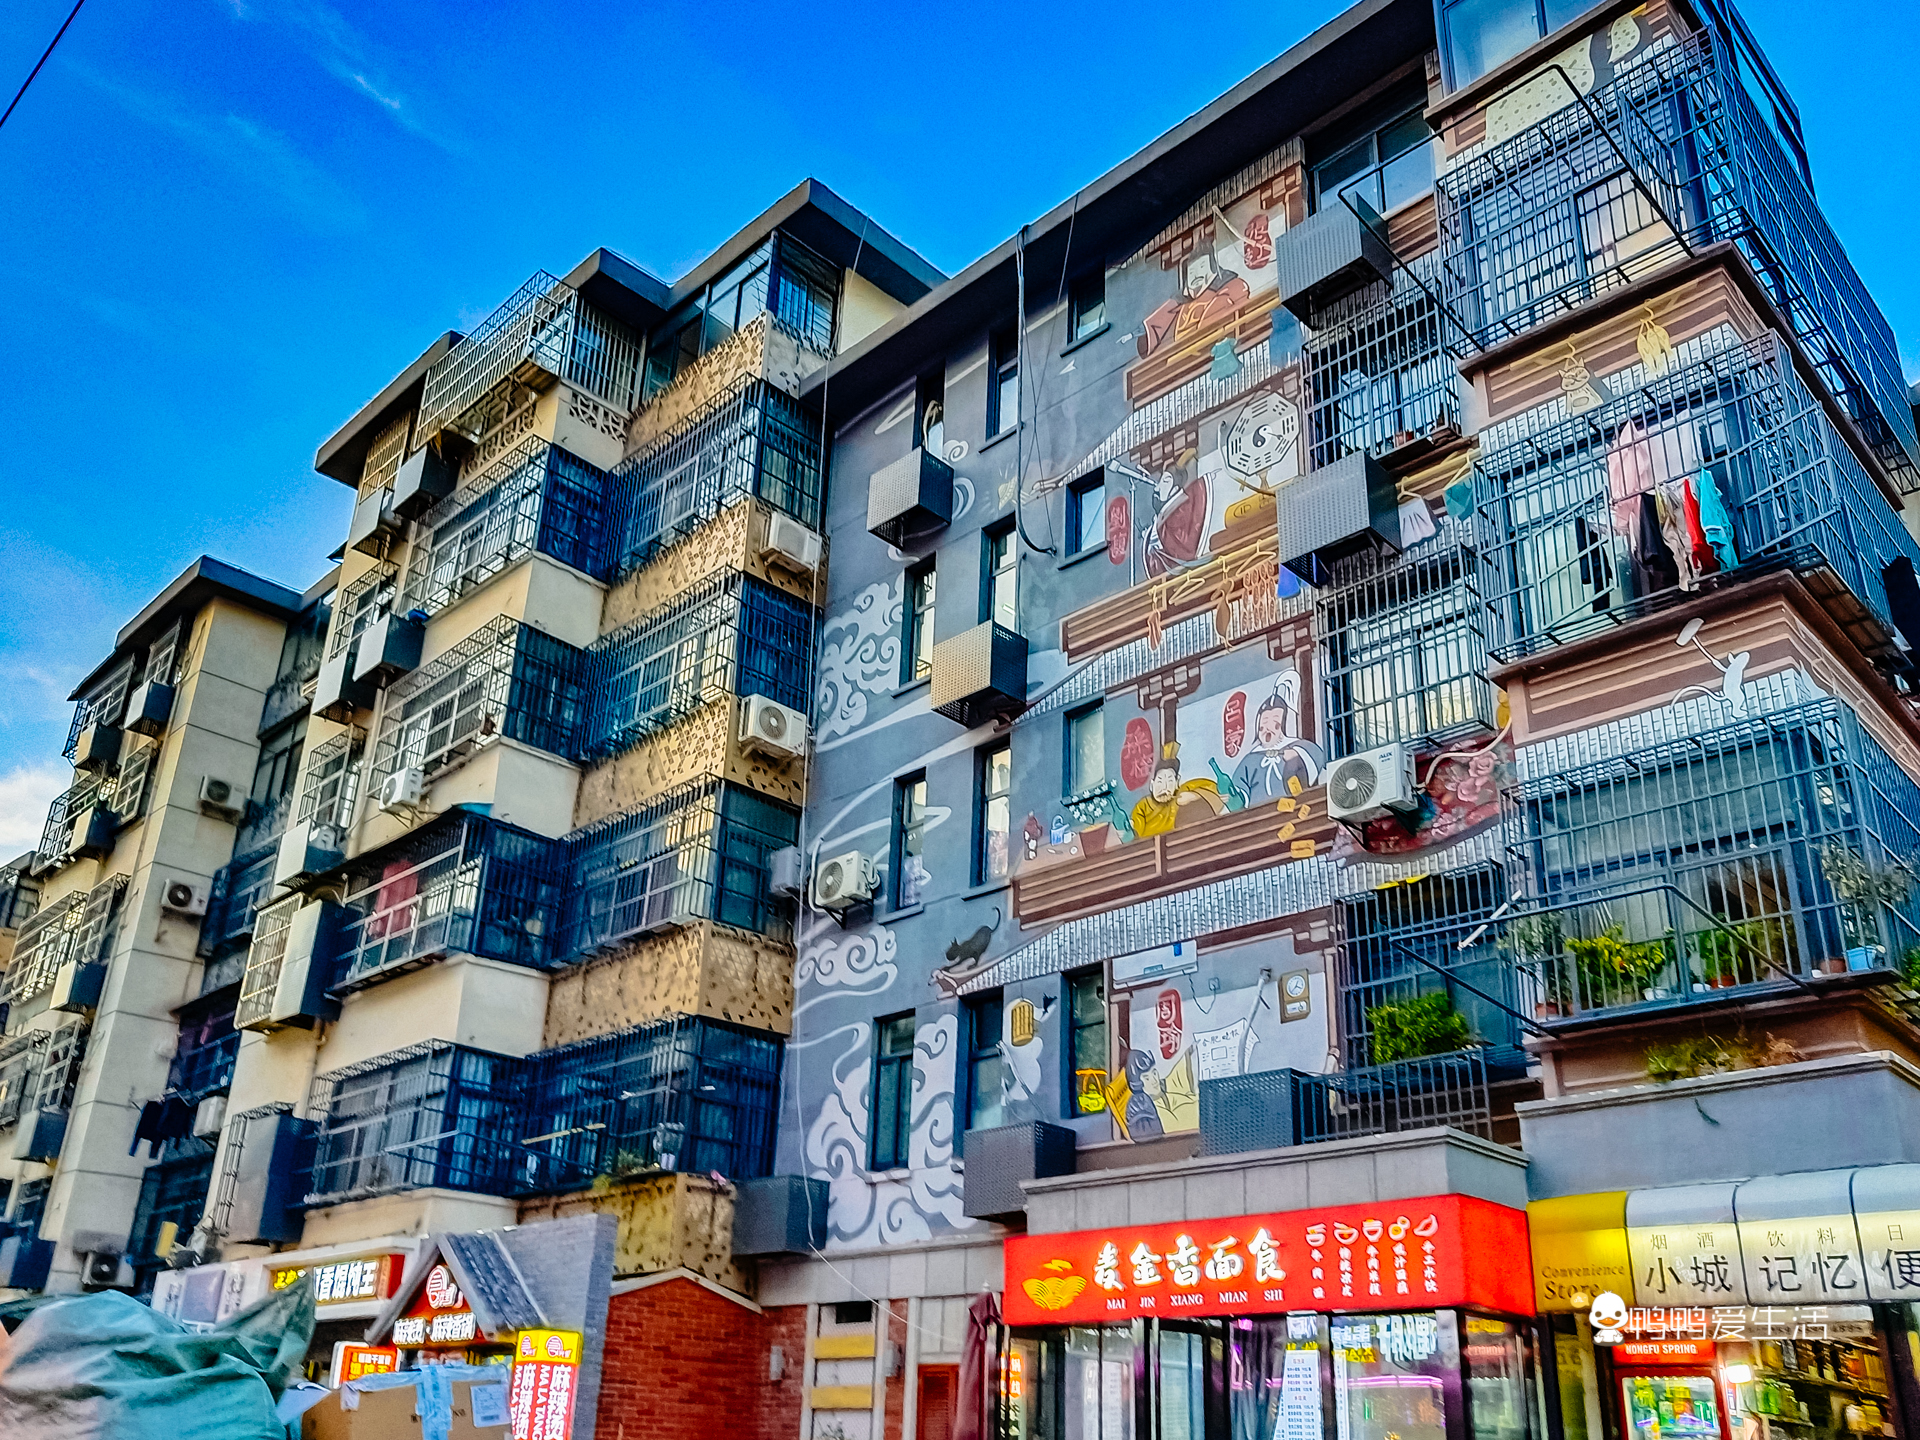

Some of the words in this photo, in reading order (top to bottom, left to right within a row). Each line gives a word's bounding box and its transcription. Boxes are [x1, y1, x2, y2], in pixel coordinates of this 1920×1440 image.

[1541, 1264, 1625, 1278] Convenience
[314, 1261, 378, 1301] 香馄饨王
[1544, 1281, 1601, 1300] Store
[1106, 1298, 1126, 1309] MAI
[1140, 1296, 1156, 1308] JIN
[1170, 1294, 1204, 1306] XIANG
[1219, 1291, 1248, 1303] MIAN
[1264, 1289, 1284, 1301] SHI
[1626, 1344, 1660, 1354] HONGFU
[1662, 1344, 1697, 1354] SPRING
[539, 1364, 550, 1386] MA
[537, 1388, 548, 1404] LA
[543, 1363, 572, 1440] 麻辣烫
